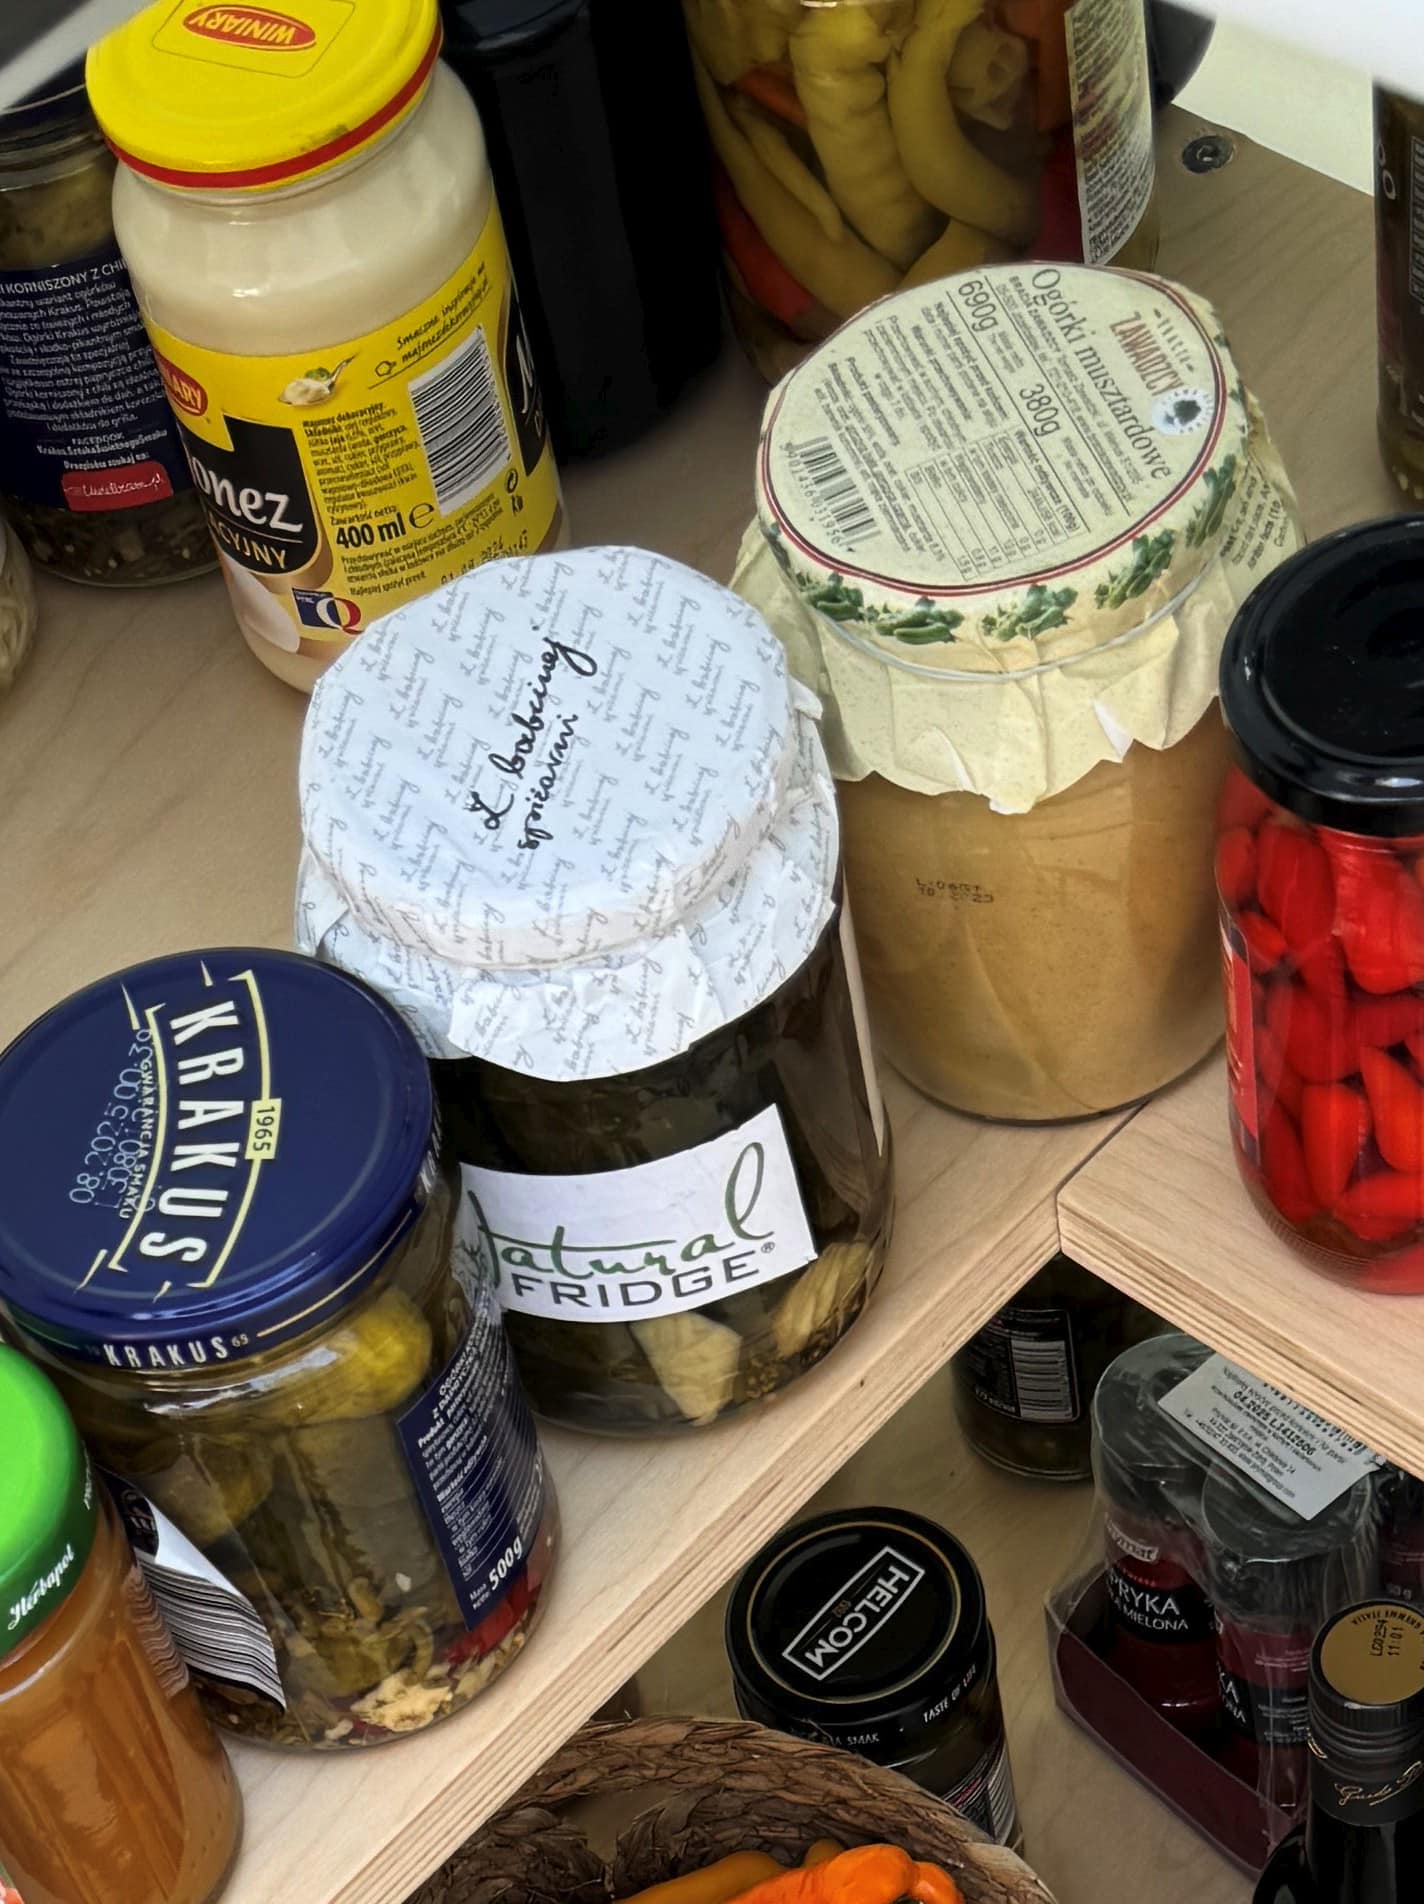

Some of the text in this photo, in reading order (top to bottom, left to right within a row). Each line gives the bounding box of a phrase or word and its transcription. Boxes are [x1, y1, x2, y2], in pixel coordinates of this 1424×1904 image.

[189, 9, 298, 45] WINIARY
[956, 278, 1000, 334] 690g
[1032, 267, 1173, 481] Ogórki musztardowe
[1017, 383, 1061, 439] 380g
[335, 512, 407, 550] 400 ml
[138, 1000, 244, 1263] KRAKUS
[252, 1105, 276, 1153] 1965
[511, 1253, 760, 1310] FRIDGE
[101, 1334, 228, 1368] KRAKUS
[6, 1543, 76, 1631] Herbapol
[804, 1564, 911, 1669] HELCOM
